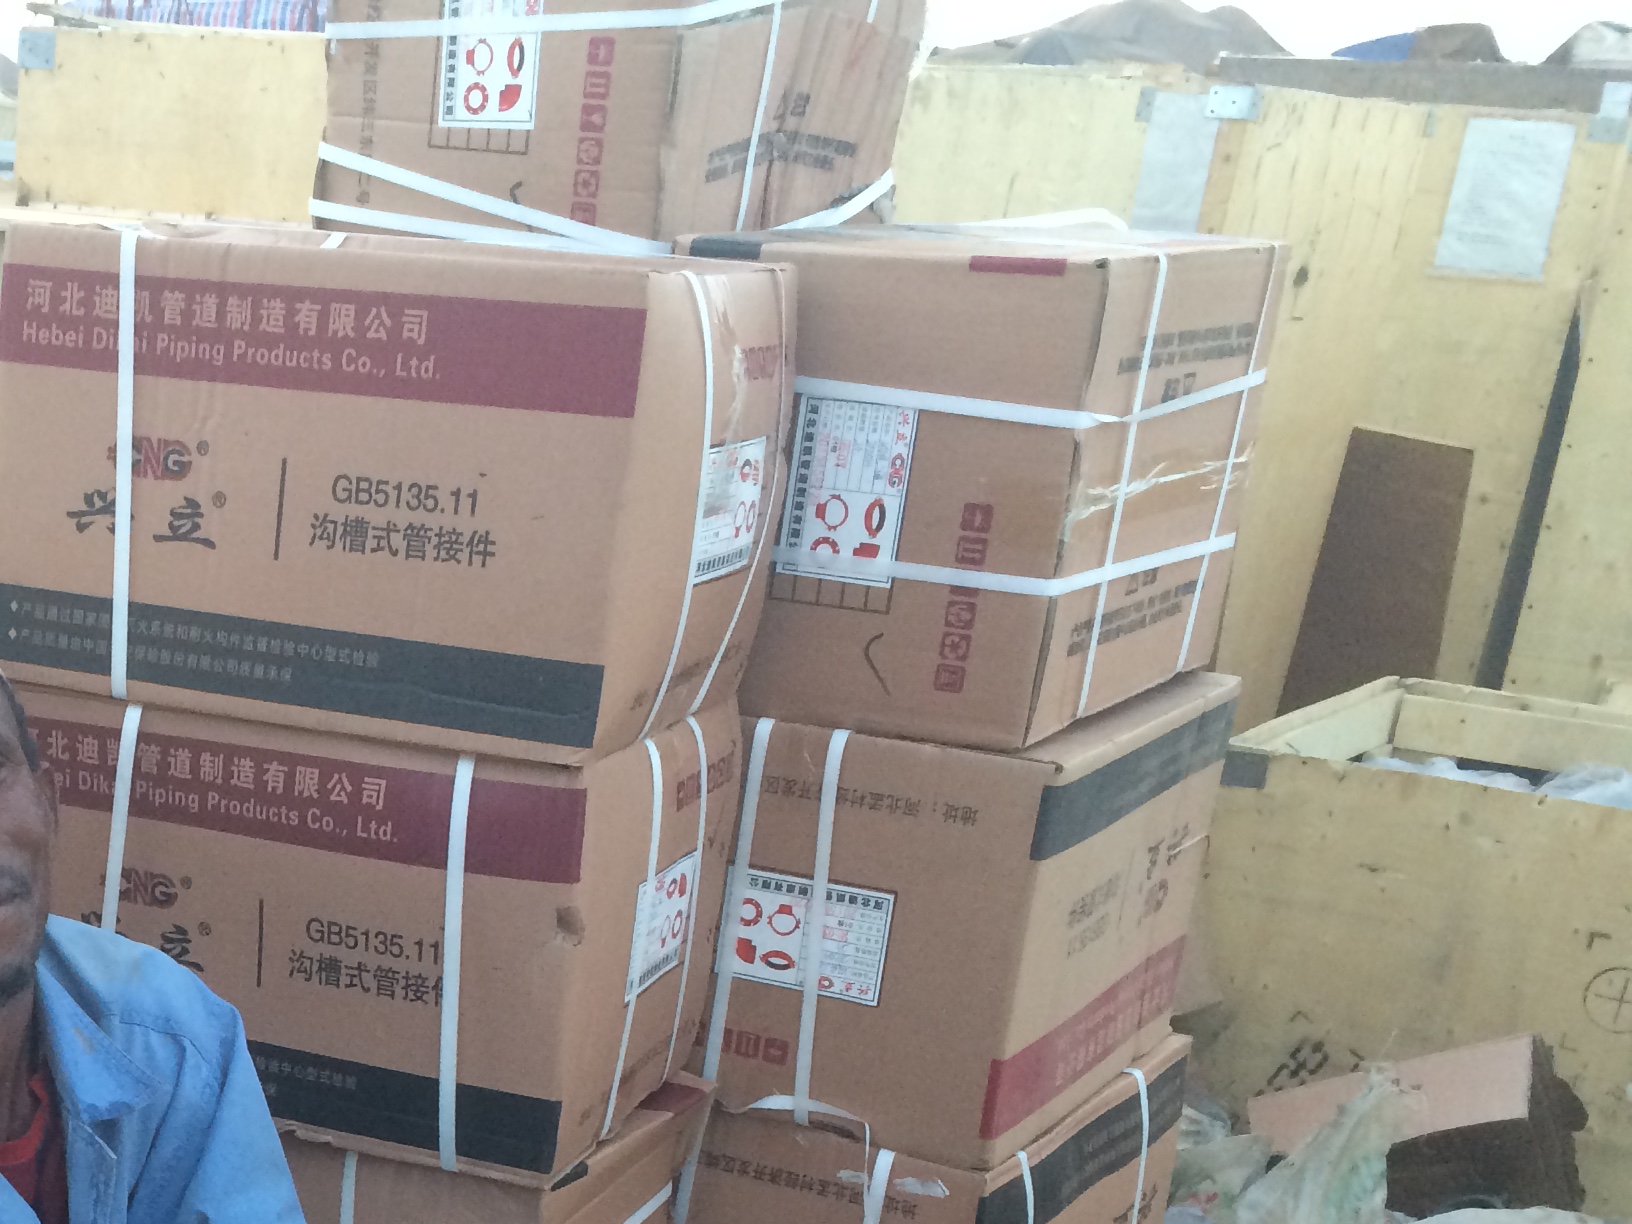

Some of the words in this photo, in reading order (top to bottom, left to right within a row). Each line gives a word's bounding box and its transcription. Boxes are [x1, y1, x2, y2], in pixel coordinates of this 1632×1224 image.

[22, 320, 85, 349] Hebei
[155, 332, 225, 366] Piping
[231, 343, 333, 371] Products
[340, 348, 386, 378] Co.,
[395, 352, 441, 381] Ltd.
[330, 473, 480, 518] GB5135.11
[308, 511, 497, 569] 沟槽式管接件
[135, 779, 200, 813] Piping
[207, 790, 300, 826] Products
[306, 807, 348, 837] Co.,
[356, 816, 399, 843] Ltd.
[305, 916, 442, 966] GB5135.11
